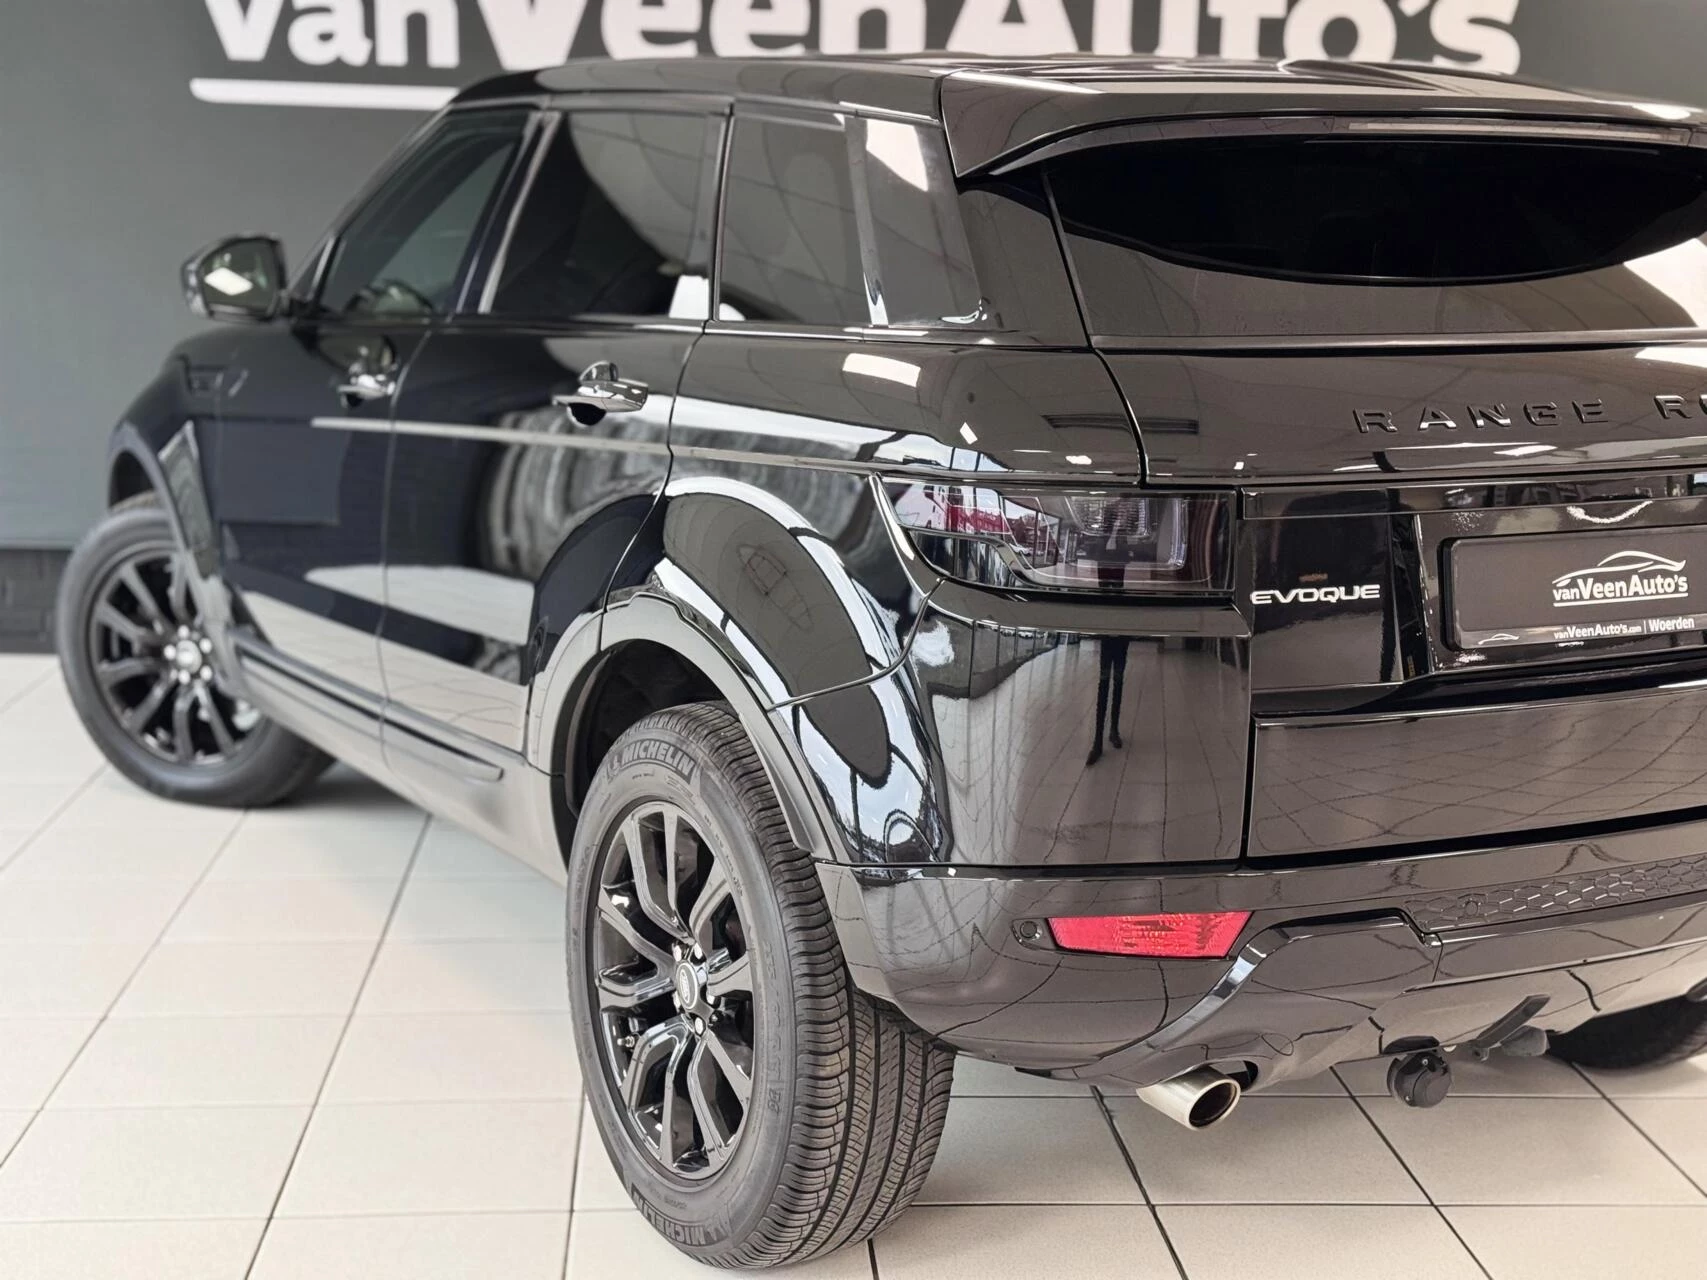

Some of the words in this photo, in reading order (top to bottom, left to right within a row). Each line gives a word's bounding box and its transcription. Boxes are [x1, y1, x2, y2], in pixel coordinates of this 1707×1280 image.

[1353, 399, 1608, 433] RANGE
[1653, 394, 1707, 419] R
[1250, 584, 1380, 604] EVOQUE
[1553, 574, 1688, 600] vanVeenAuto's
[1648, 617, 1695, 632] Woerden
[622, 740, 696, 777] MICHELIN
[631, 1190, 706, 1245] MICHELIN
